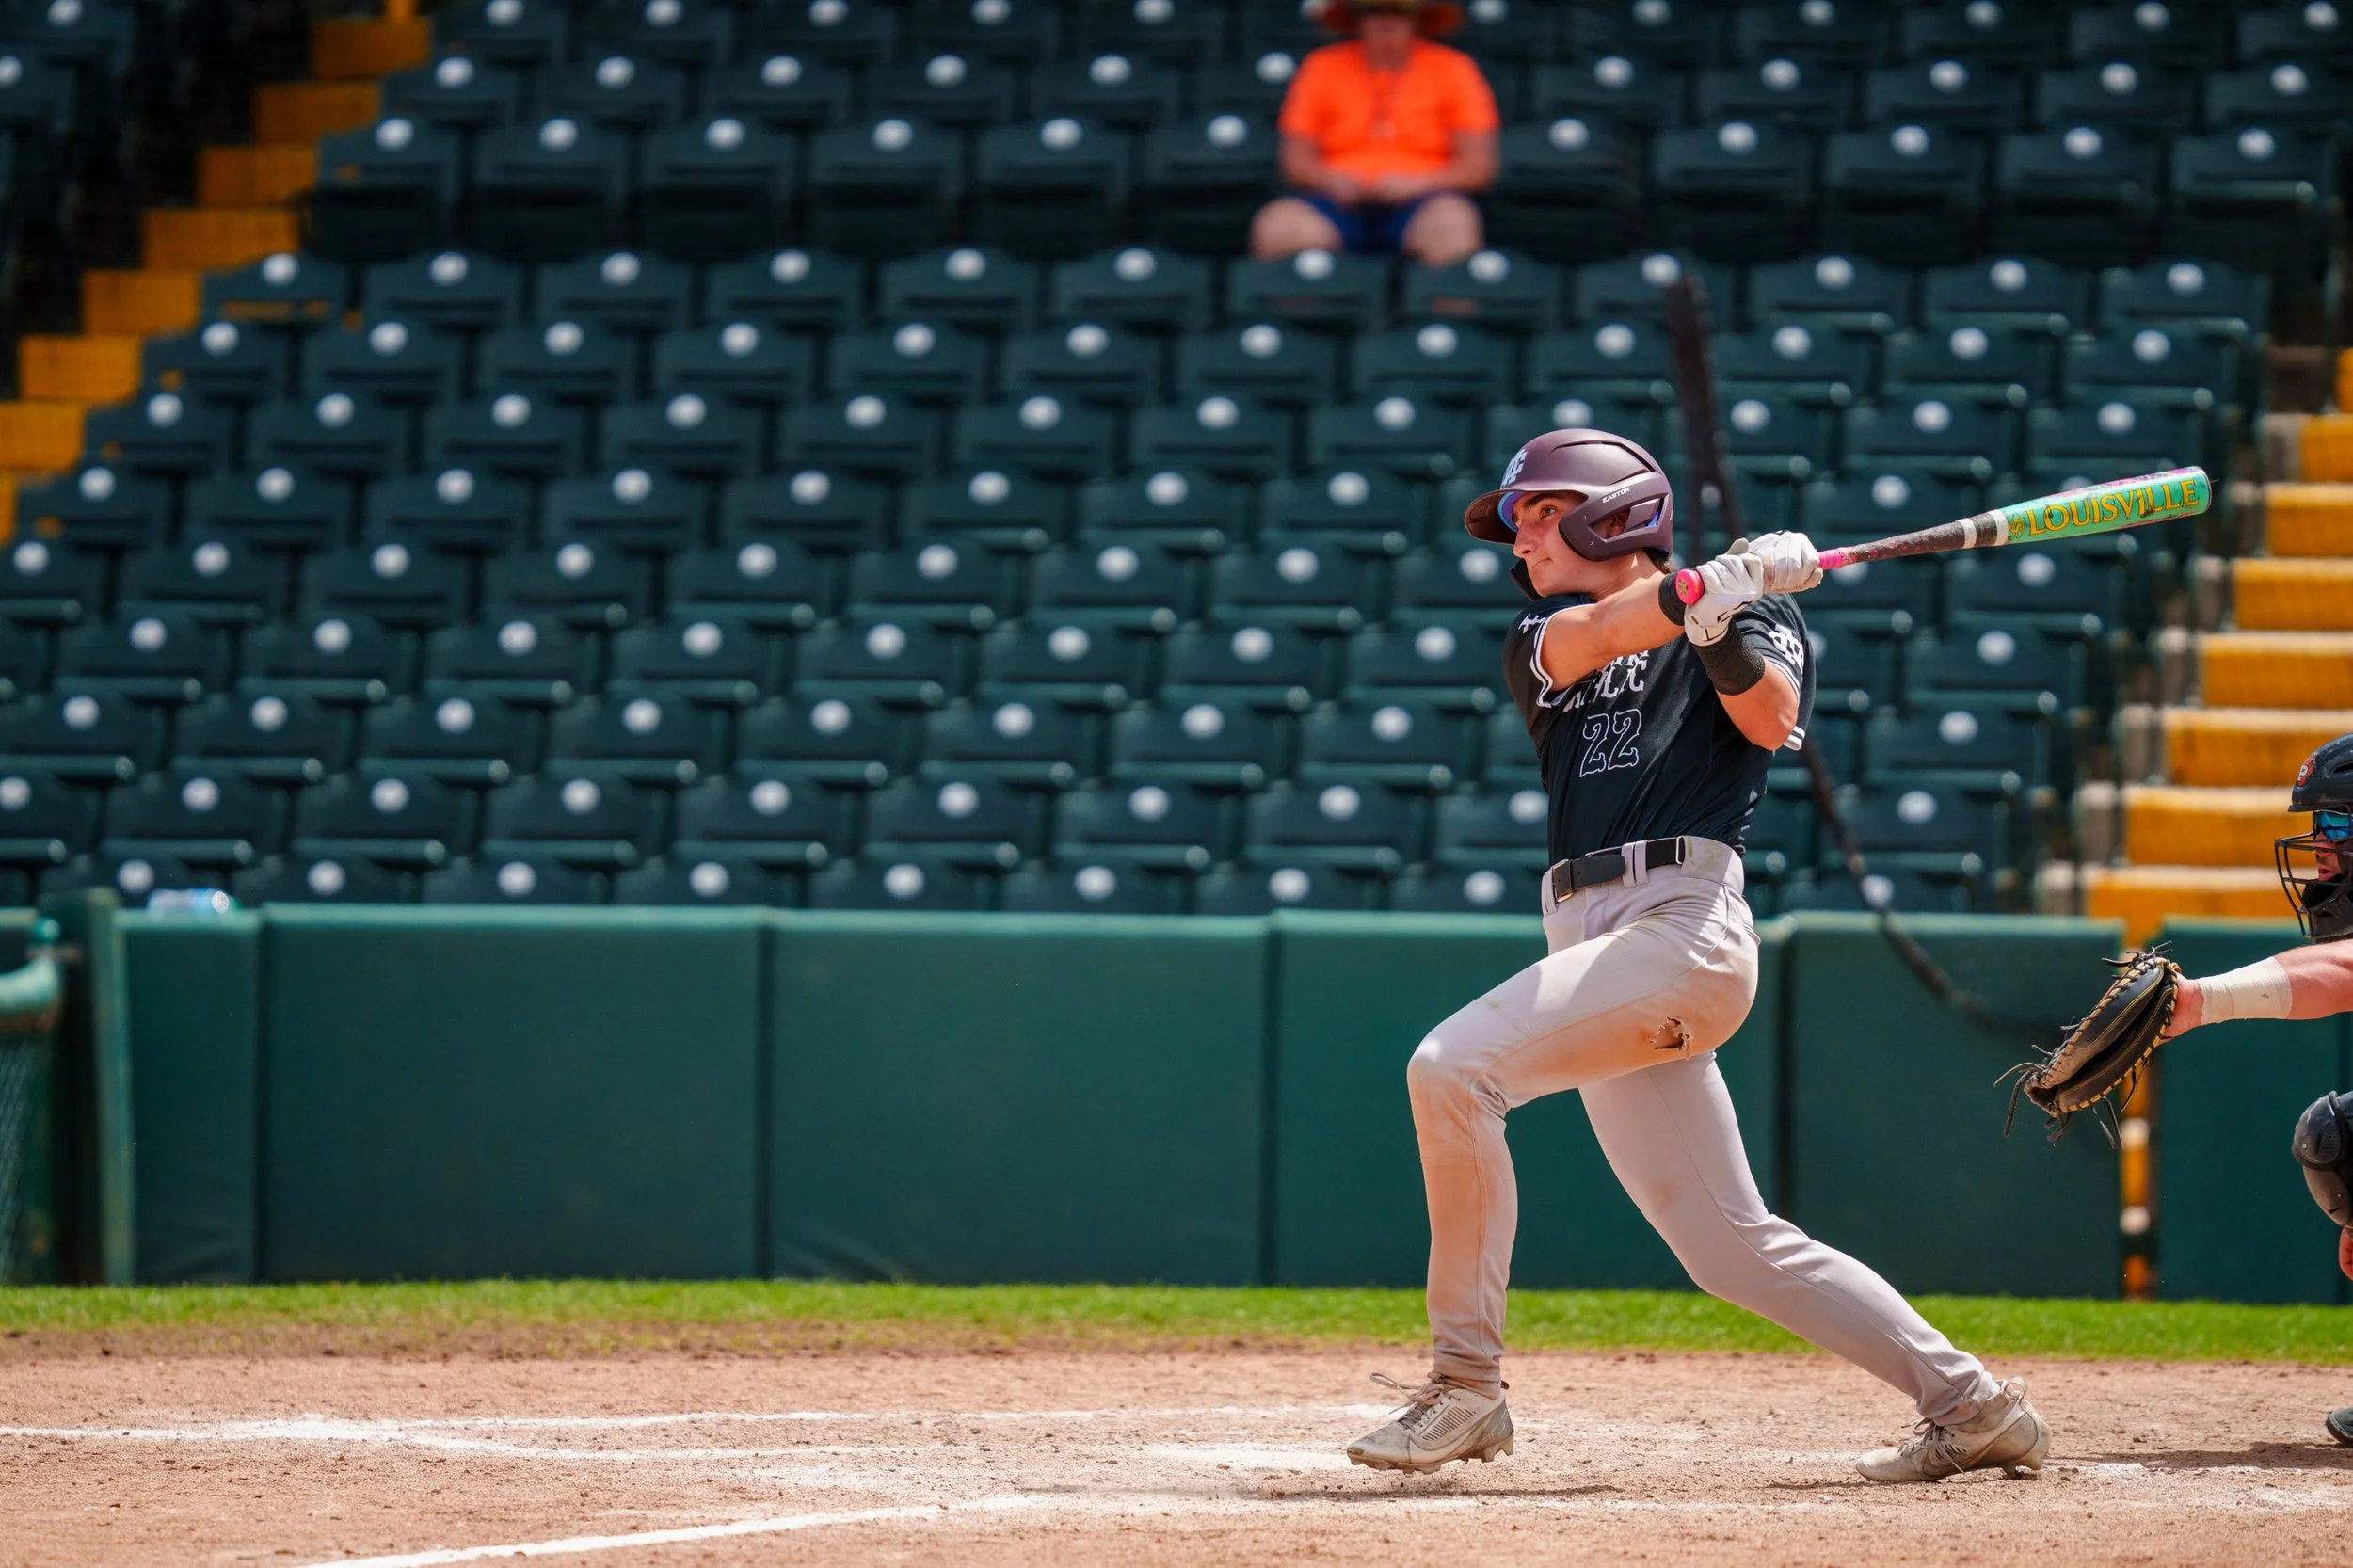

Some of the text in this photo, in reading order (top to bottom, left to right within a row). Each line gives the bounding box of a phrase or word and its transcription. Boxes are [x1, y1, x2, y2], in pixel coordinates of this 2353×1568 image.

[1602, 487, 1630, 503] EASTON
[2025, 479, 2200, 536] LOUISVILLE
[1579, 708, 1641, 777] 22
